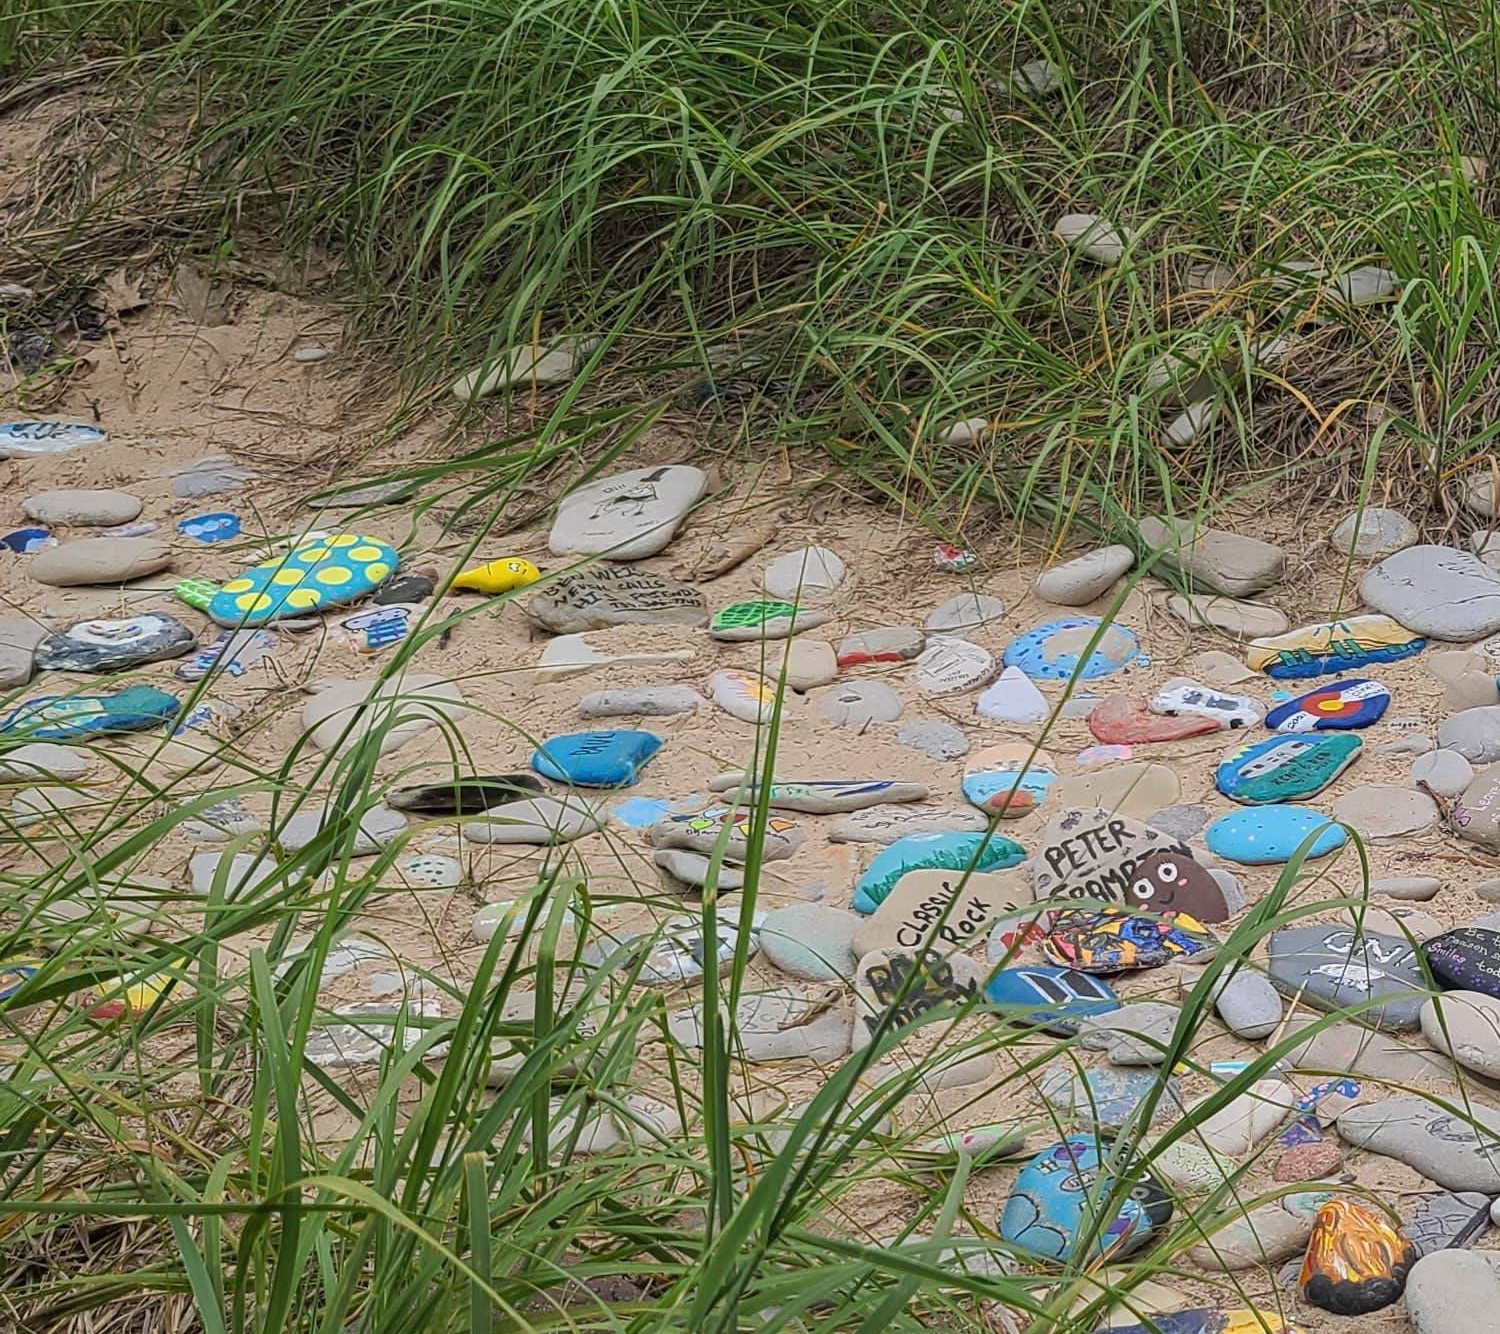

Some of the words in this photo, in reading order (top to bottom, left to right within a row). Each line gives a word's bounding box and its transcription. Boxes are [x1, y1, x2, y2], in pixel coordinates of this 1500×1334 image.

[542, 571, 585, 597] BEN
[617, 579, 666, 591] CALLS
[1044, 820, 1137, 879] PETER
[1445, 935, 1488, 956] reason
